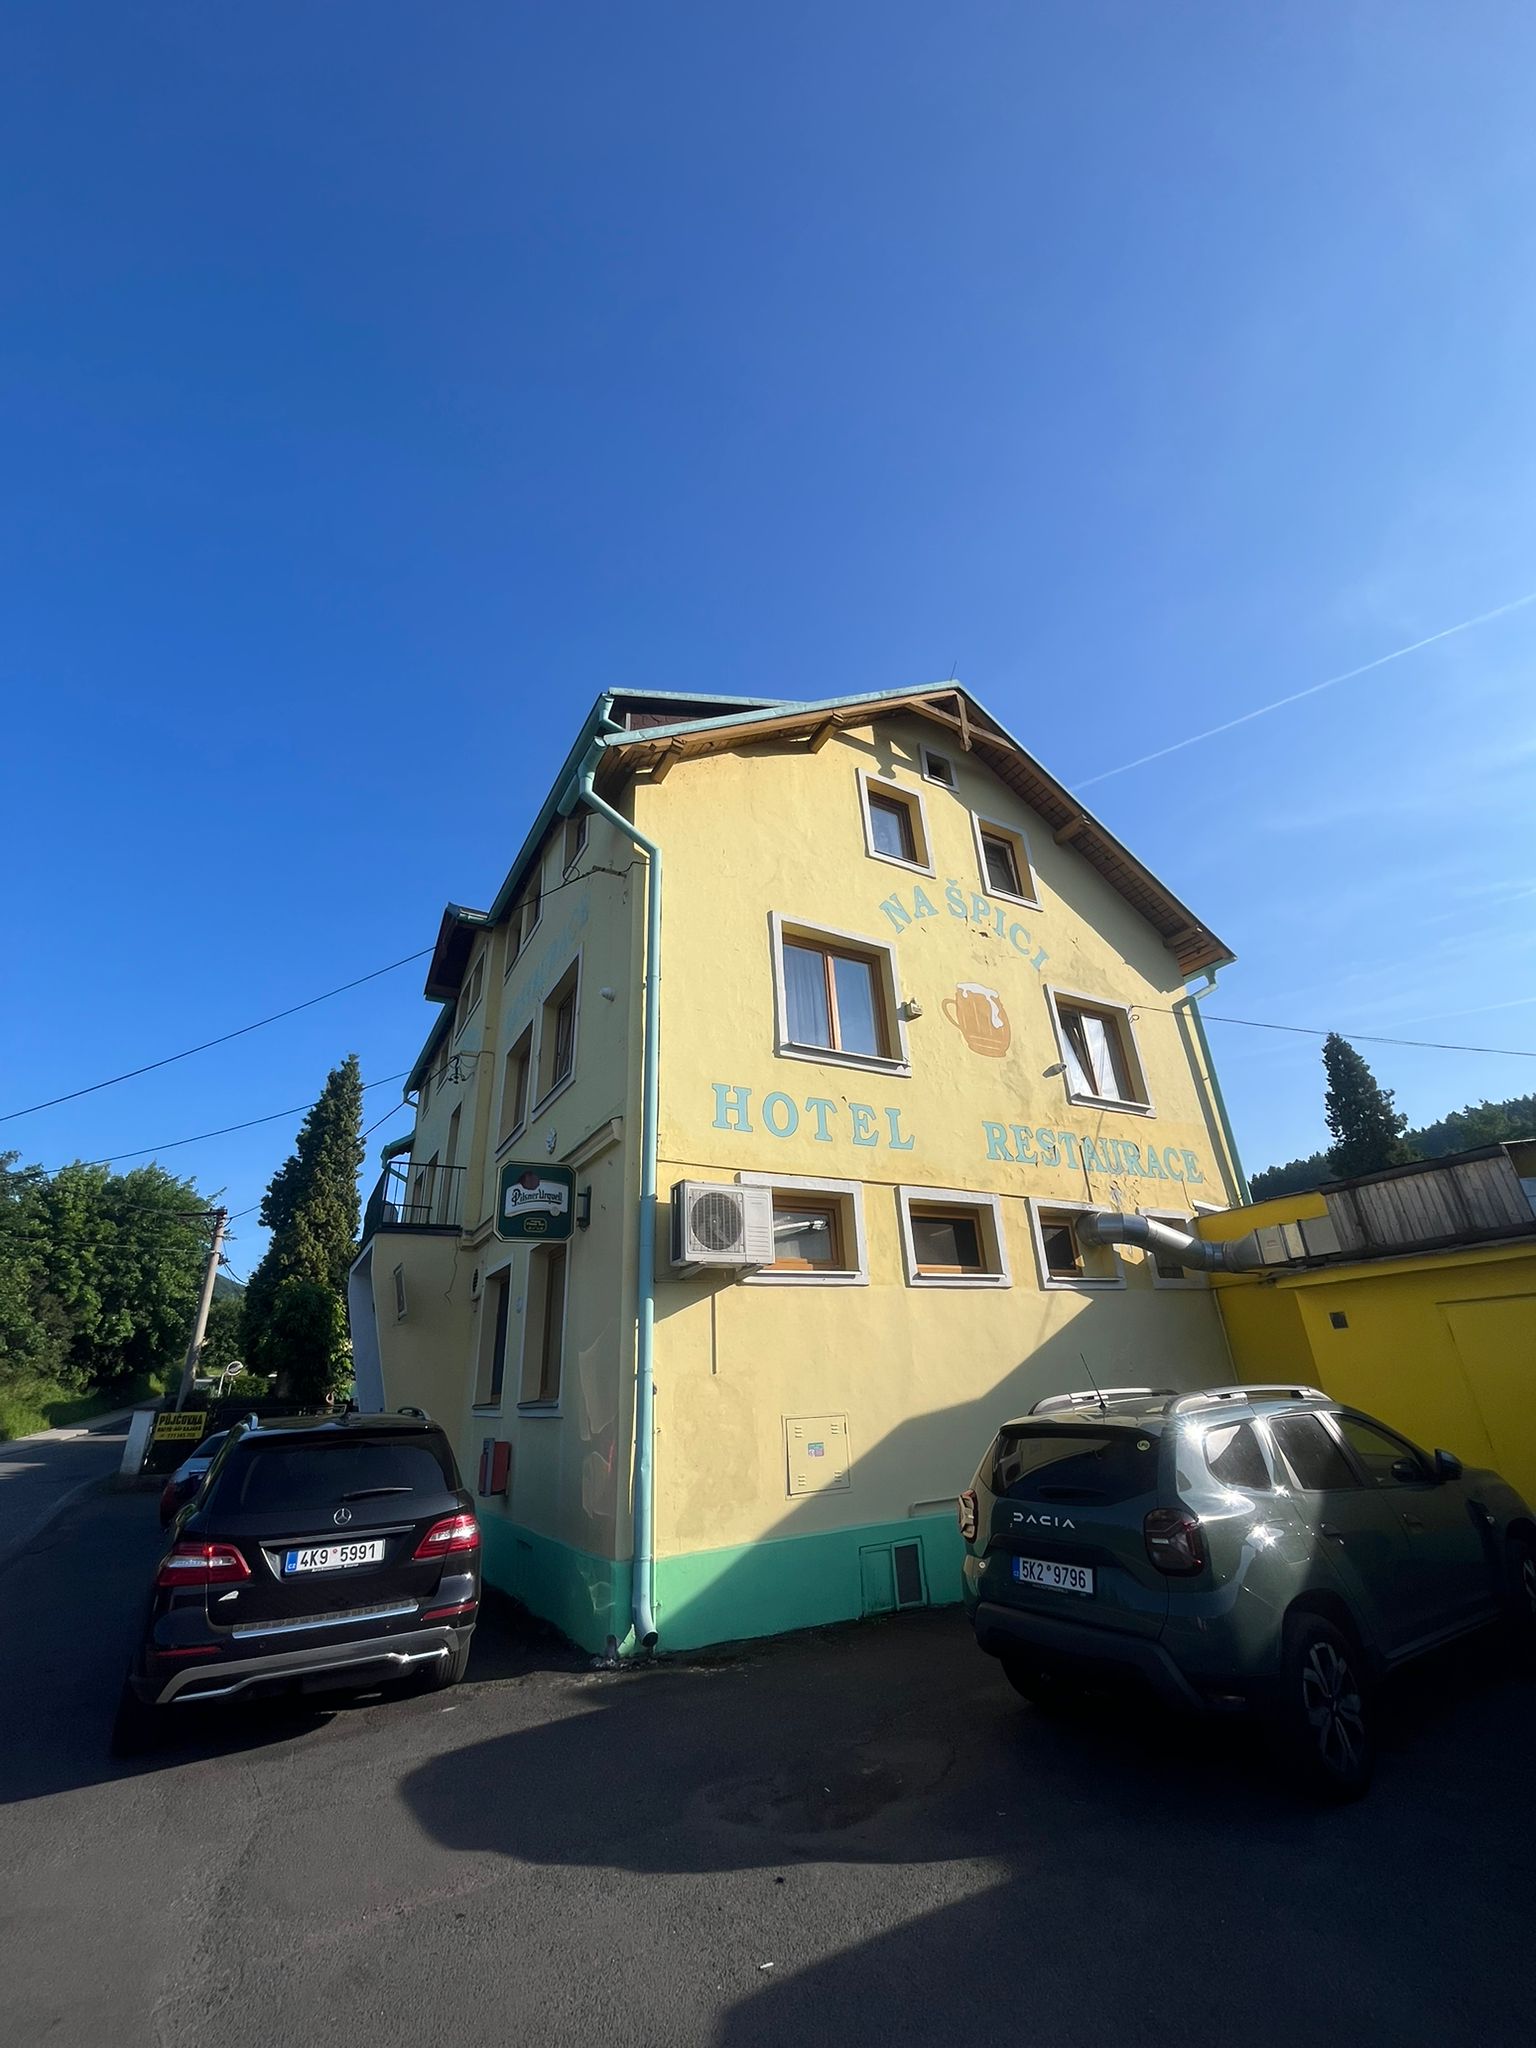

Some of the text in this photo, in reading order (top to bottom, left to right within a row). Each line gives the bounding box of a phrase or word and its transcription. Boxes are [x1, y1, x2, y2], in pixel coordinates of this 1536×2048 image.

[879, 879, 1050, 972] NA ŠPICI
[711, 1082, 916, 1151] HOTEL
[982, 1120, 1204, 1184] RESTAURACE
[1013, 1512, 1075, 1528] DACIA
[300, 1549, 329, 1567] 4K9
[340, 1543, 376, 1562] 5991
[1022, 1560, 1044, 1582] 5K2
[1053, 1565, 1087, 1589] 9796
